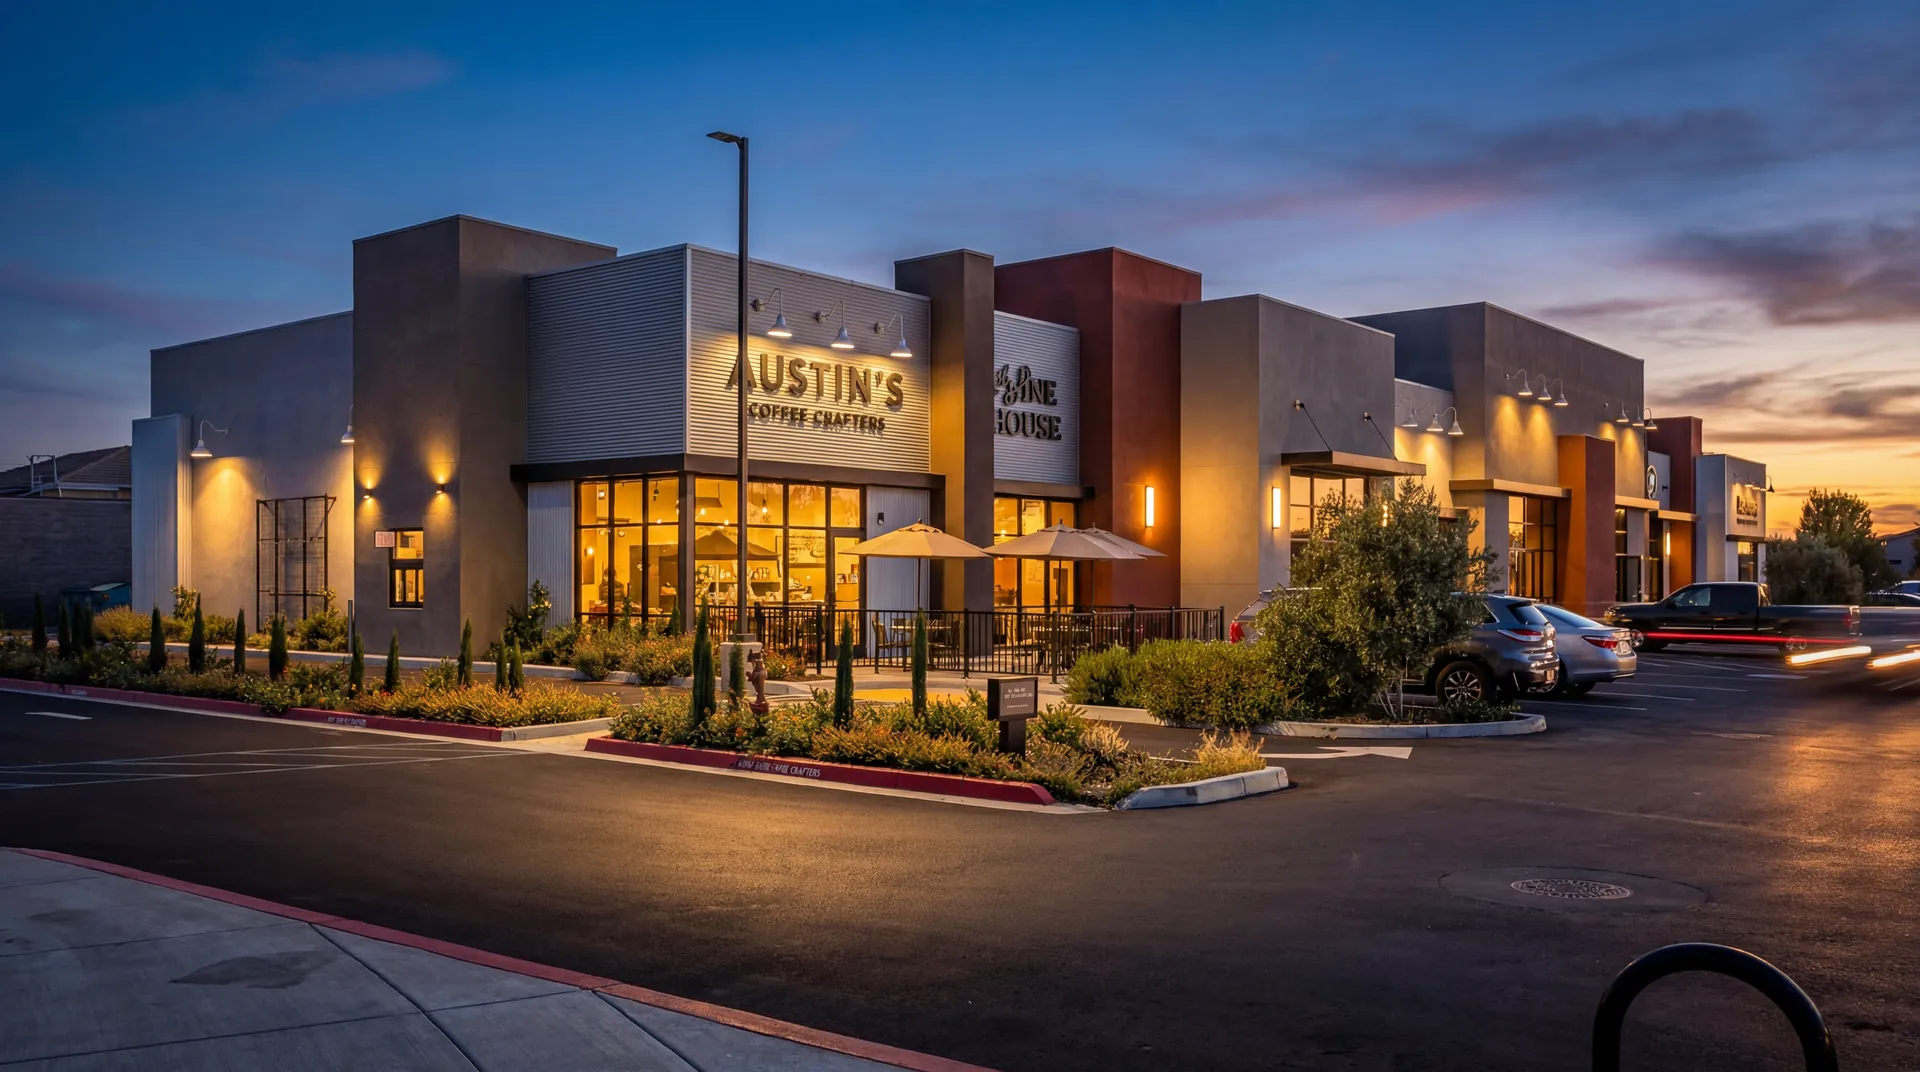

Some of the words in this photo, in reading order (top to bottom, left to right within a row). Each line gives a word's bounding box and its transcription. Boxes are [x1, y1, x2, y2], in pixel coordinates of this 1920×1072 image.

[725, 350, 904, 409] AUSTIN'S
[747, 402, 809, 423] COFFEE
[993, 408, 1062, 441] HOUSE
